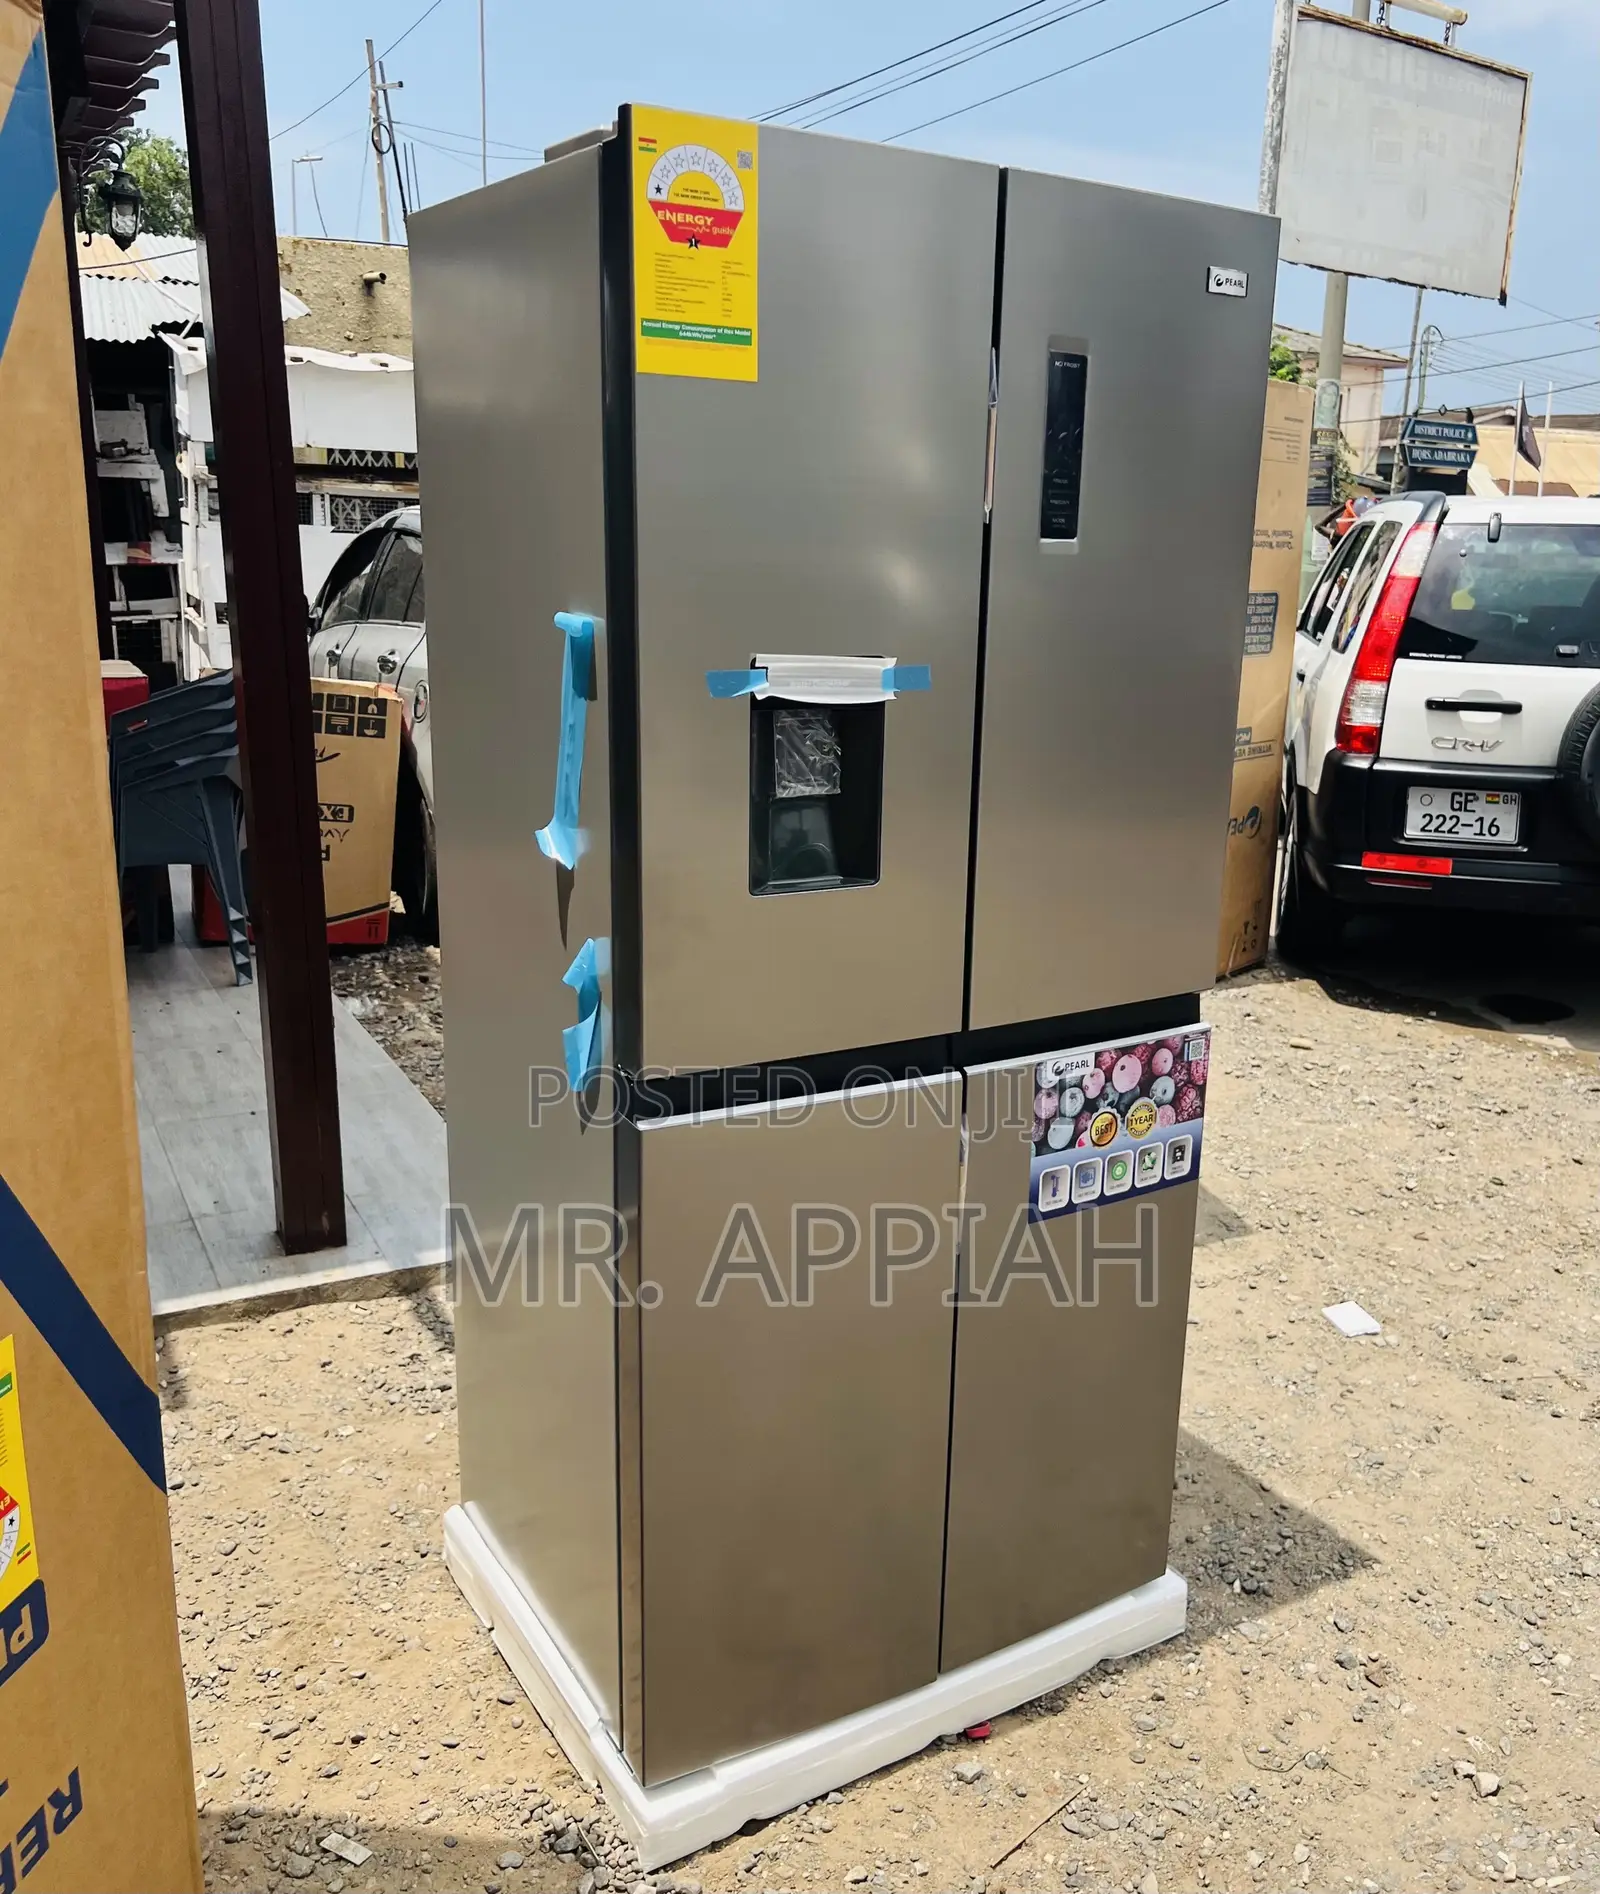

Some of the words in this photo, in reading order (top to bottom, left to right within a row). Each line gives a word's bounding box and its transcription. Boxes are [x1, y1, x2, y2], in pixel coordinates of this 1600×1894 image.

[657, 209, 714, 226] ENERGY
[712, 226, 735, 235] guide
[1225, 277, 1245, 289] PEARL
[643, 320, 662, 328] Annual
[662, 322, 681, 331] Energy
[681, 324, 717, 333] Consumption
[1063, 361, 1081, 369] FROST
[1414, 424, 1442, 437] DISTRICT
[1442, 427, 1466, 439] POLICE
[1432, 450, 1471, 464] ADABRAKA
[1450, 791, 1477, 813] GE
[1502, 794, 1517, 805] GH
[1420, 813, 1500, 837] 222-16
[1064, 1060, 1090, 1071] PEARL
[1095, 1122, 1113, 1136] BEST
